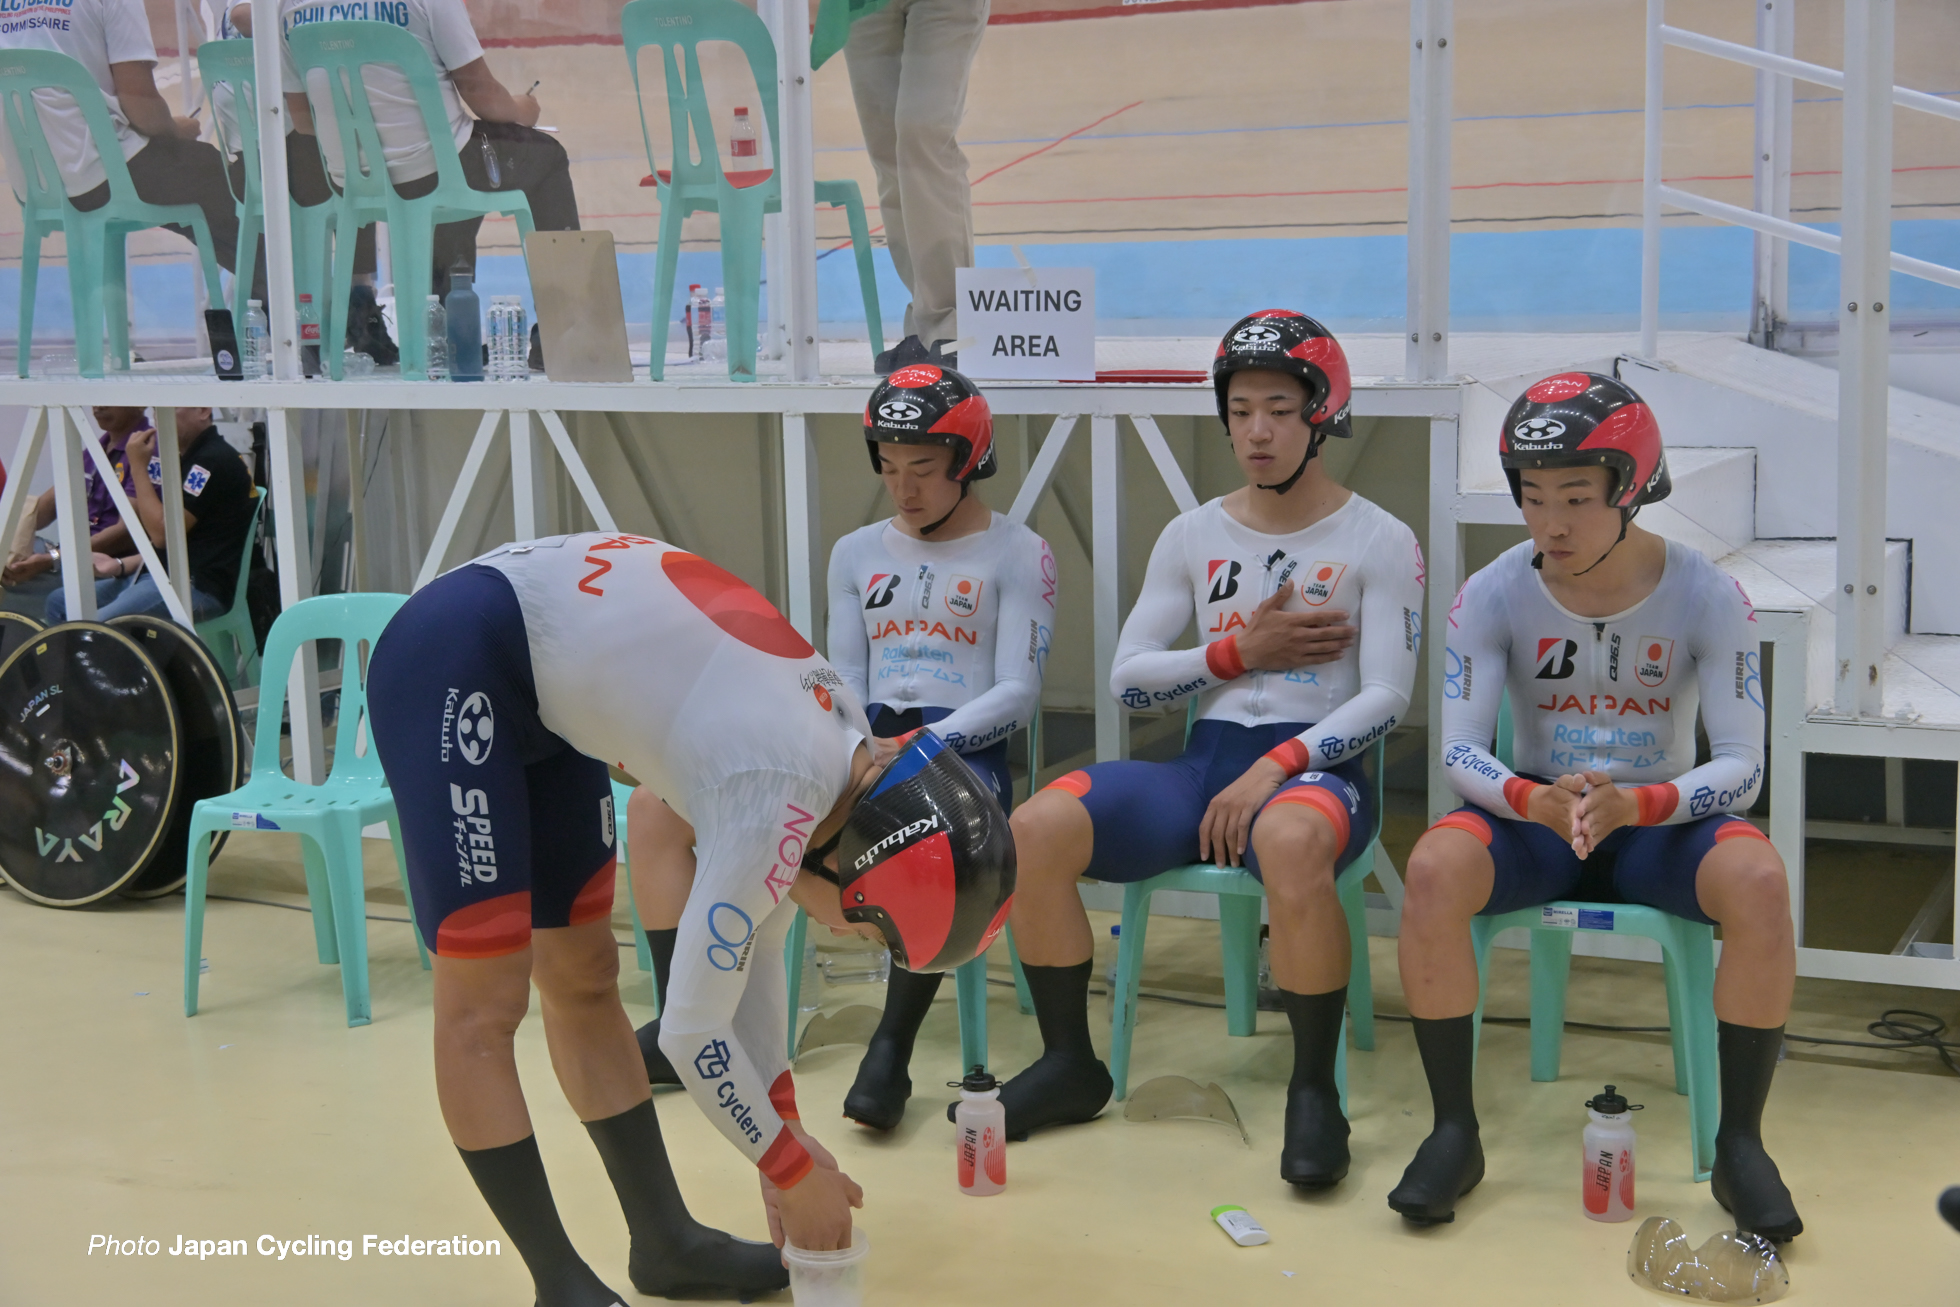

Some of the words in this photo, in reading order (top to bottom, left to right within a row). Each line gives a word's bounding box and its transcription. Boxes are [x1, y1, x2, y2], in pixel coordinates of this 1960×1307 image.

[0, 17, 70, 33] OMMISSAIRE
[655, 15, 693, 27] TOLENTINO
[0, 65, 26, 76] LENTINO
[225, 56, 254, 67] TOLENTIN
[968, 290, 1082, 312] WAITING
[992, 335, 1060, 357] AREA
[1231, 344, 1277, 352] Kabuto
[1534, 379, 1583, 388] JAPAN
[877, 420, 919, 430] Kabuto
[1514, 442, 1564, 451] Kabuto
[578, 533, 657, 597] PAN
[922, 572, 935, 610] Q36.5
[949, 598, 973, 611] JAPAN
[1305, 586, 1329, 598] JAPAN
[872, 619, 977, 645] JAPAN
[1027, 618, 1038, 664] KEIRIN
[1403, 606, 1413, 652] KEIRIN
[1609, 632, 1621, 682] Q36.5
[1462, 655, 1472, 701] KEIRIN
[1640, 667, 1664, 678] JAPAN
[1736, 651, 1744, 699] KEIRIN
[1153, 677, 1207, 701] Cyclers
[20, 688, 49, 723] JAPAN
[50, 684, 63, 695] SL
[1537, 694, 1670, 716] JAPAN
[441, 687, 459, 762] Kabuto
[969, 720, 1017, 747] Cyclers
[1348, 715, 1396, 750] Cyclers
[1553, 723, 1656, 747] Rakuten
[1462, 754, 1502, 780] Cyclers
[1718, 763, 1761, 807] Cyclers
[35, 758, 140, 863] ARAYA
[450, 782, 498, 883] SPEED
[854, 815, 938, 870] Kabuto
[453, 817, 473, 888] チャンネル
[717, 1081, 762, 1144] Cyclers
[964, 1127, 977, 1167] JAPAN
[1596, 1150, 1613, 1191] JAPAN
